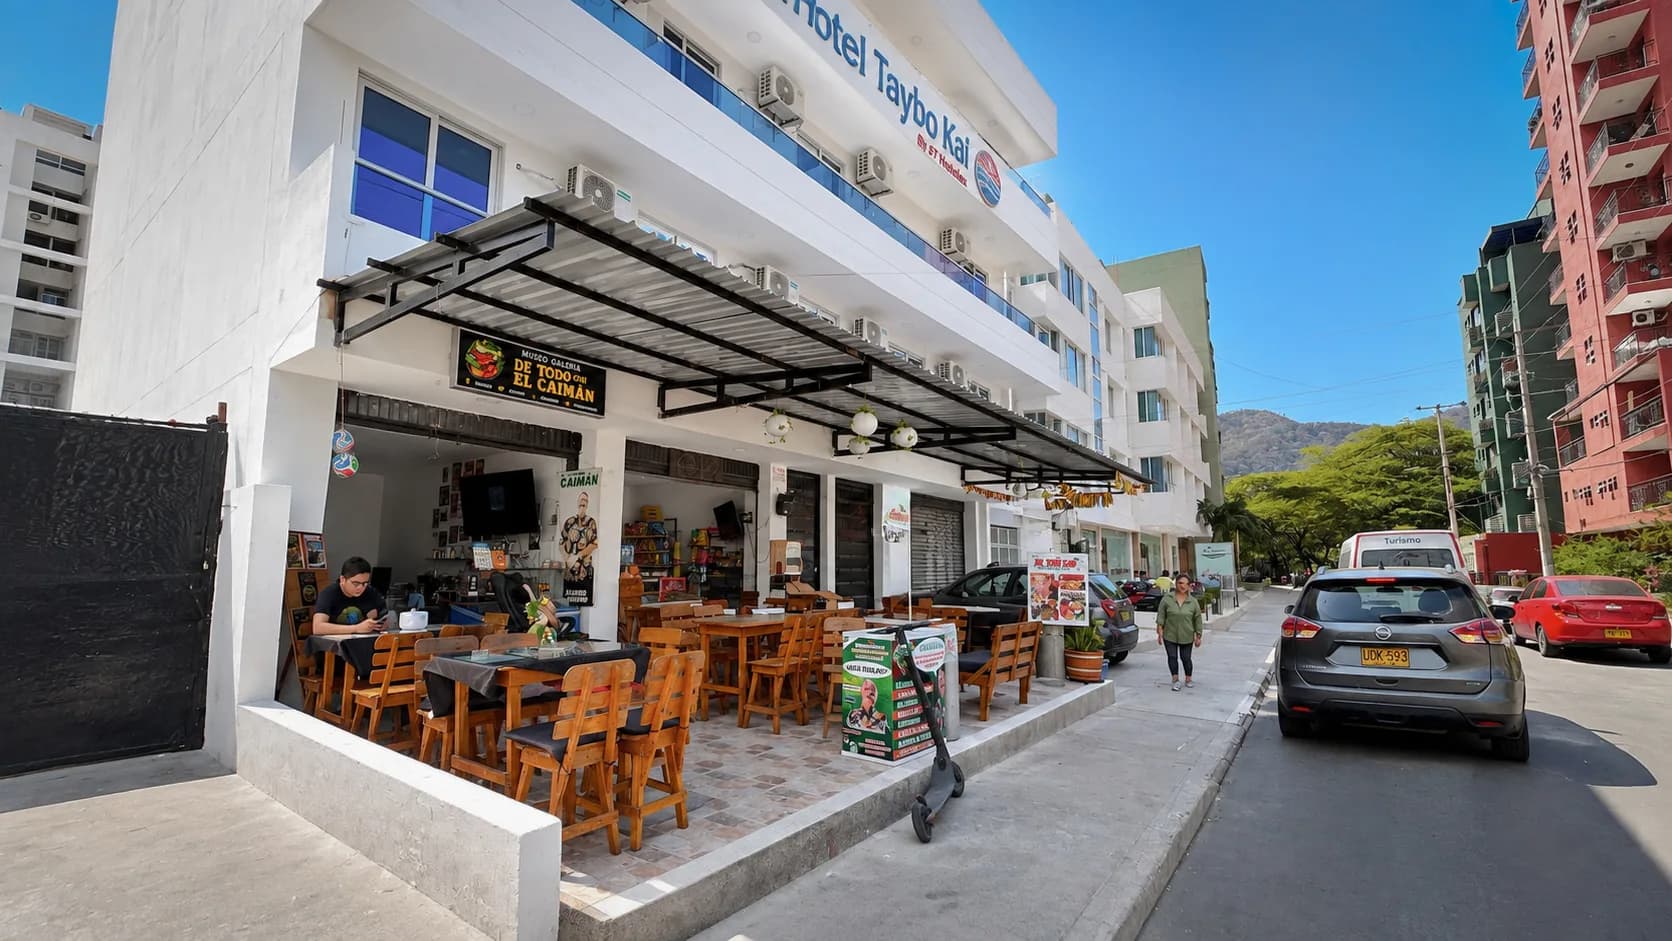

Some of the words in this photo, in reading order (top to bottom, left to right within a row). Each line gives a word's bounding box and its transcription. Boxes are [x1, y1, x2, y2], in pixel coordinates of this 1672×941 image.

[873, 48, 939, 140] Taybo
[942, 114, 970, 170] Kai
[513, 358, 532, 374] DE
[537, 364, 571, 382] TODO
[513, 372, 533, 389] EL
[1384, 536, 1421, 545] Turismo
